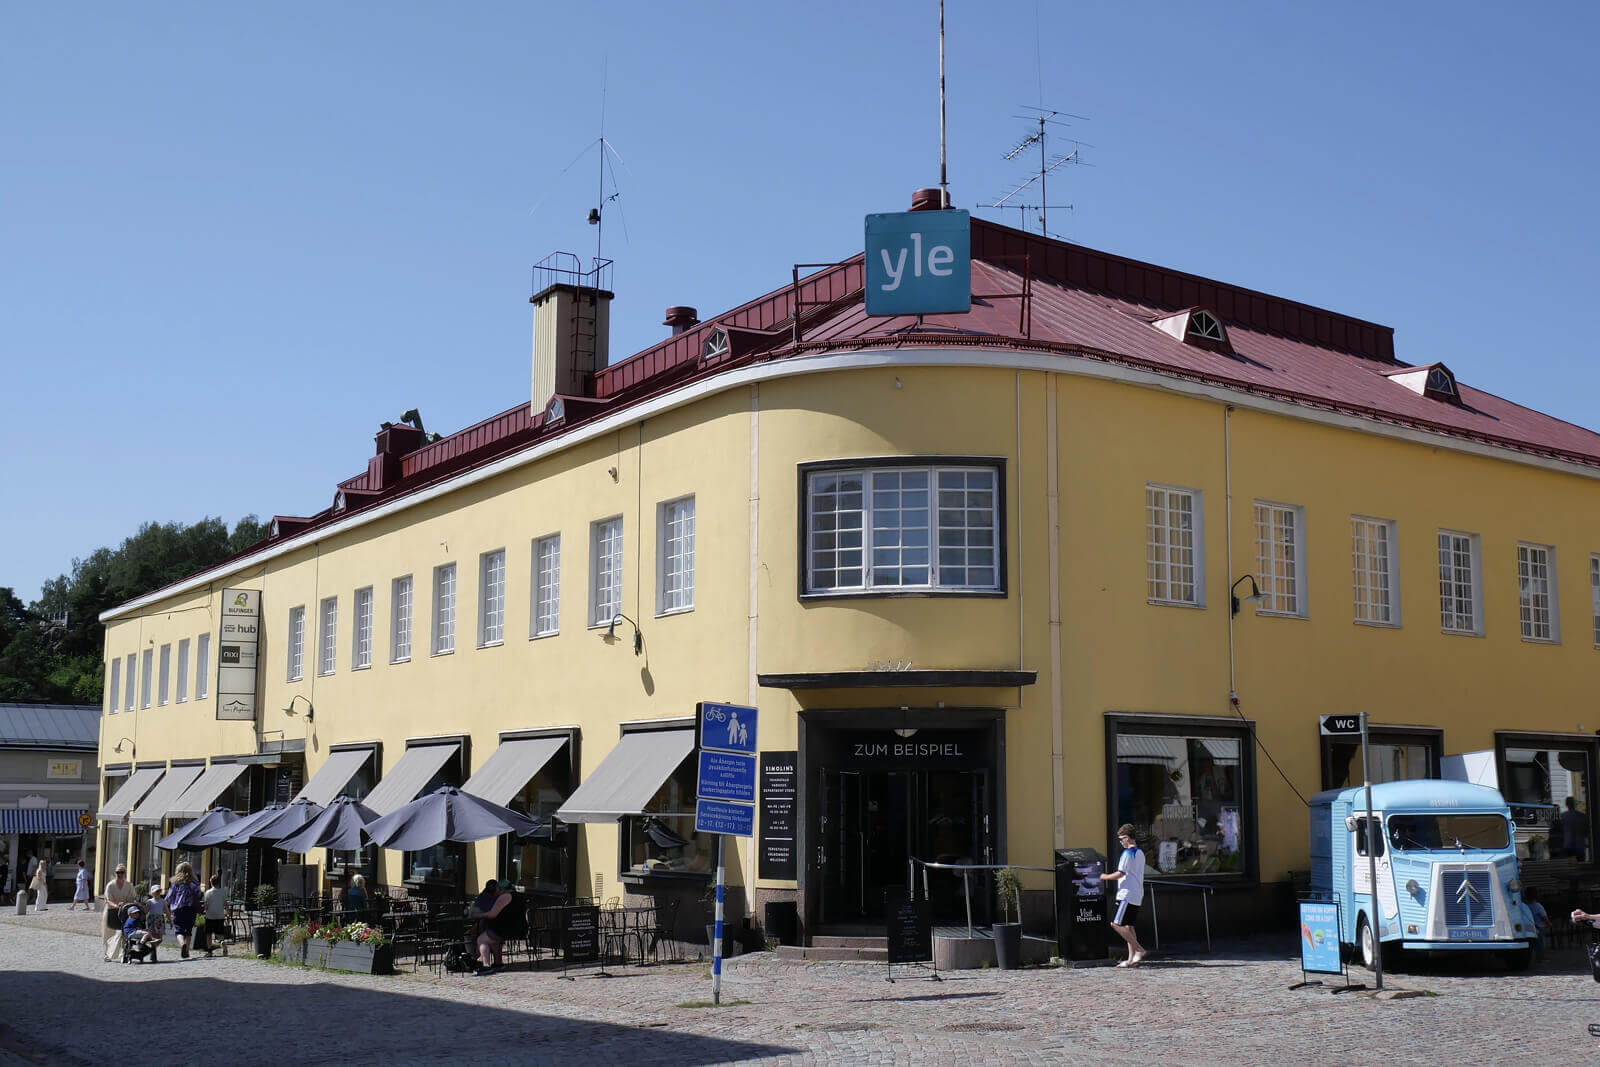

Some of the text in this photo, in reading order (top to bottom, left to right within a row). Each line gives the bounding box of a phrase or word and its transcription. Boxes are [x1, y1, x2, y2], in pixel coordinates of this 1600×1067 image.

[881, 232, 954, 291] yle
[237, 624, 257, 634] hub
[1335, 719, 1355, 729] WC
[854, 743, 963, 756] ZUM BEISPIEL
